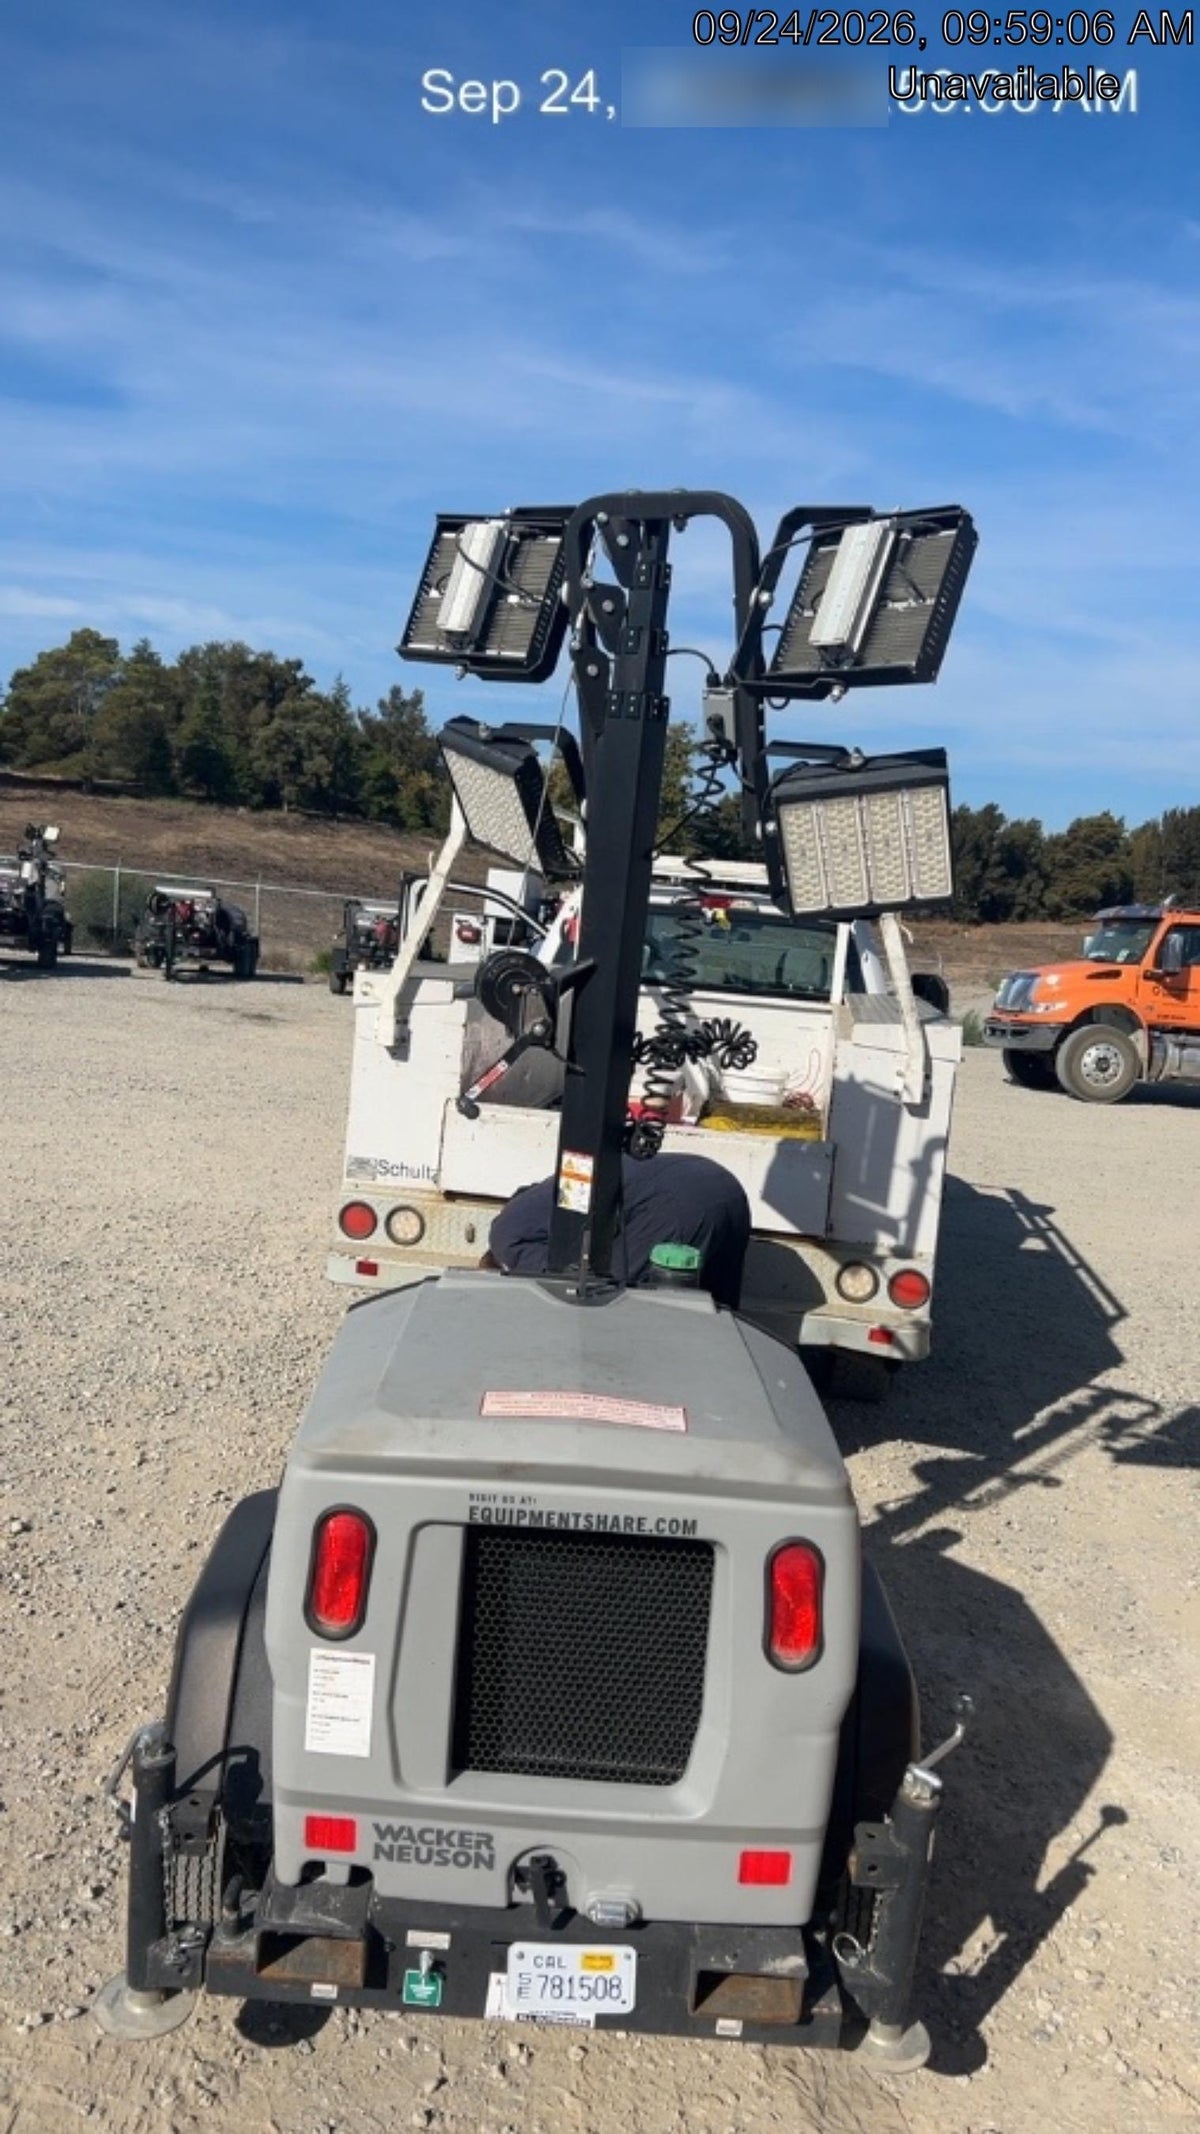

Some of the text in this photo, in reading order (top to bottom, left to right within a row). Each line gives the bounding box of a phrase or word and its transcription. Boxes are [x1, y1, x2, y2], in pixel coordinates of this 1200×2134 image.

[469, 1505, 698, 1536] EQUIPMENTSHARE.COM
[372, 1822, 494, 1850] WACKER
[373, 1842, 495, 1871] NEUSON
[533, 1955, 567, 1969] CAL
[536, 1974, 622, 2001] 781508
